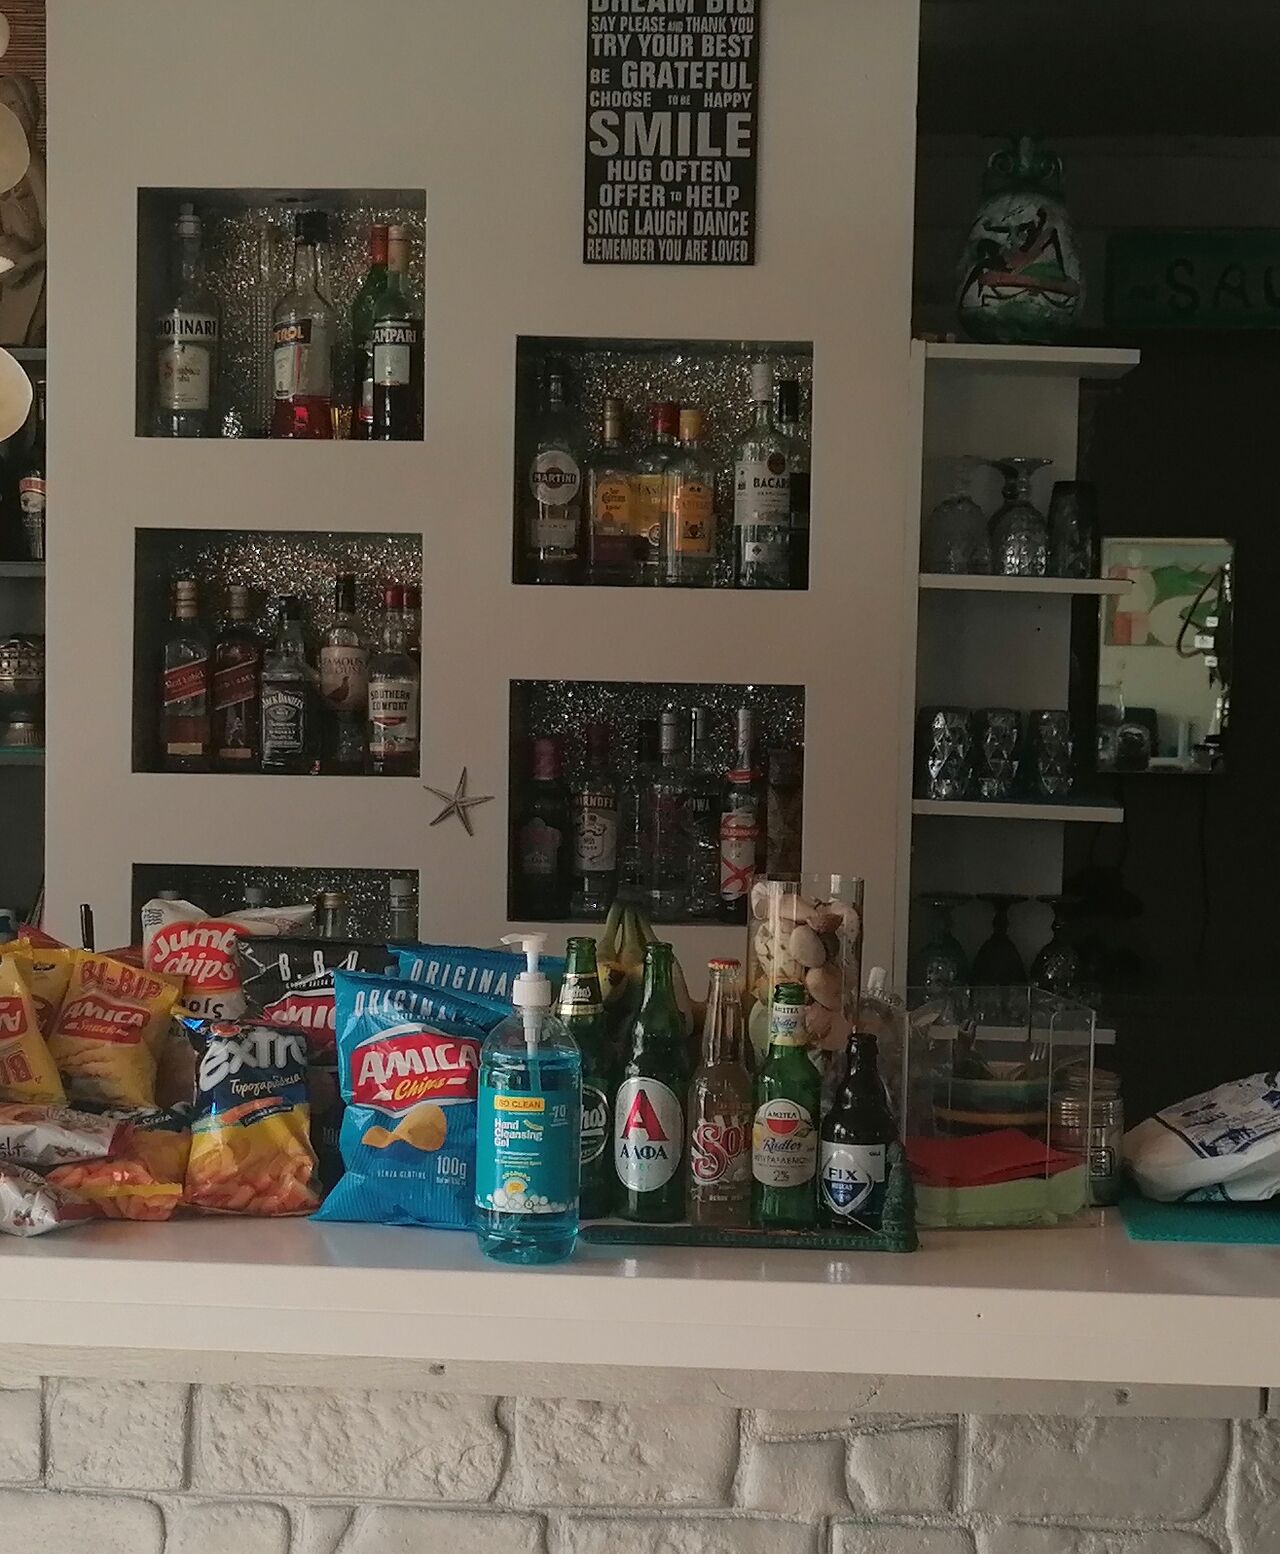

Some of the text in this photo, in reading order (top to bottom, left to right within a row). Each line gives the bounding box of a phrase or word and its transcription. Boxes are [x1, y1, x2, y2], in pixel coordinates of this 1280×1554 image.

[591, 17, 754, 33] SAY PLEASE AND THANK YOU
[591, 34, 752, 58] TRY YOUR BEST
[591, 61, 752, 90] BE GRATEFUL
[590, 91, 752, 108] CHOOSE TO BE HAPPY
[589, 110, 751, 158] SMILE
[607, 160, 731, 183] HUG OFTEN
[599, 185, 739, 208] OFFER TO HELP
[588, 210, 749, 236] SING LAUGH DANCE
[587, 239, 748, 262] REMEMBER YOU ARE LOVED
[533, 472, 576, 483] MARTINI
[370, 689, 411, 700] SOUTHERN
[372, 701, 408, 711] COMFORT
[154, 927, 236, 964] Jumb
[162, 952, 236, 984] chips
[410, 956, 508, 997] ORIGINA
[65, 1002, 144, 1027] AMICA
[358, 1042, 480, 1086] AMICA
[393, 1076, 447, 1101] Chips
[512, 1100, 541, 1109] CLEAN
[621, 1089, 670, 1141] A
[495, 1118, 519, 1130] Hand
[495, 1127, 543, 1142] Cleansing
[495, 1137, 510, 1148] Gel
[762, 1137, 802, 1154] Radler
[436, 1154, 467, 1179] 100g
[772, 1169, 790, 1182] 2%
[829, 1167, 858, 1181] FIX
